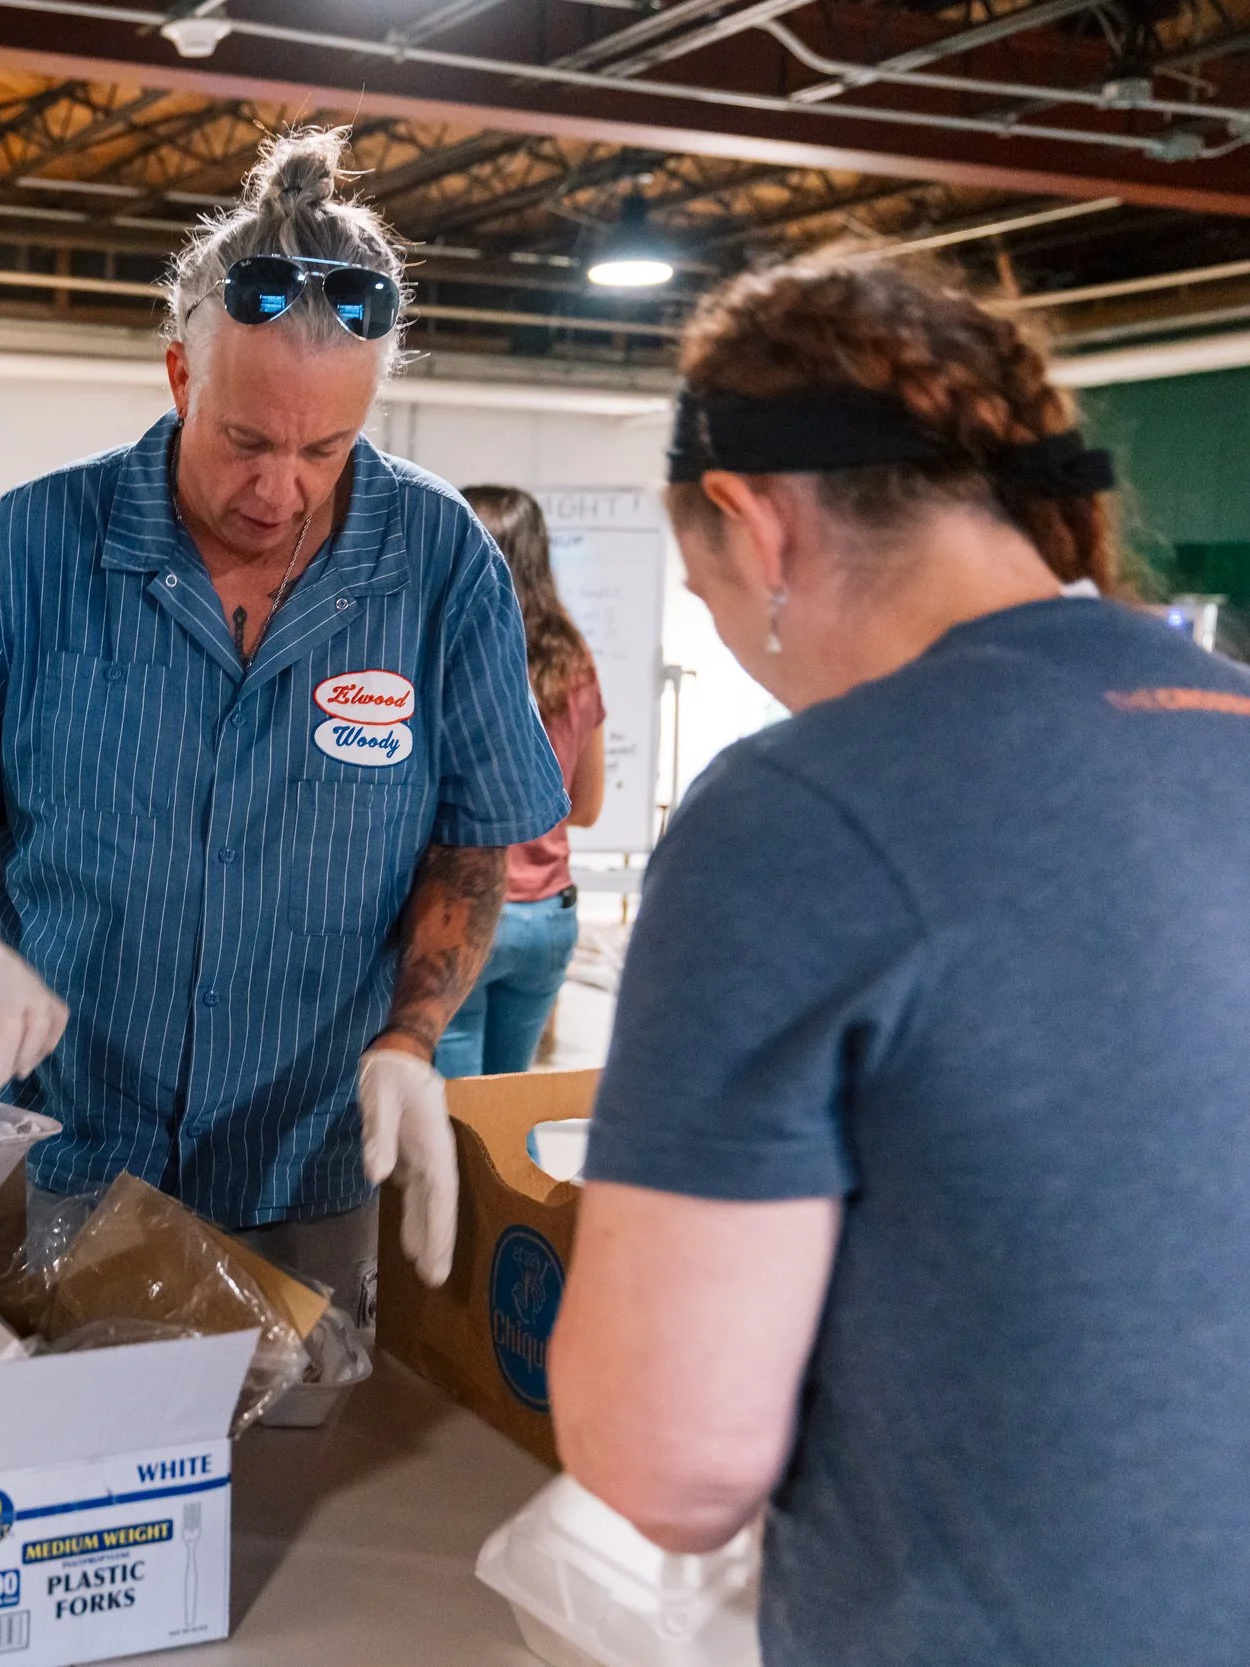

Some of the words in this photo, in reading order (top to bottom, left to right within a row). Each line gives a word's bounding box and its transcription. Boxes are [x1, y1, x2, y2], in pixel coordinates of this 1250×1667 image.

[327, 684, 411, 708] Elwood
[333, 725, 400, 758] Woody
[137, 1453, 213, 1483] WHITE
[26, 1534, 99, 1561] MEDIUM
[103, 1522, 169, 1547] WEIGHT
[47, 1560, 145, 1596] PLASTIC
[55, 1587, 136, 1619] FORKS
